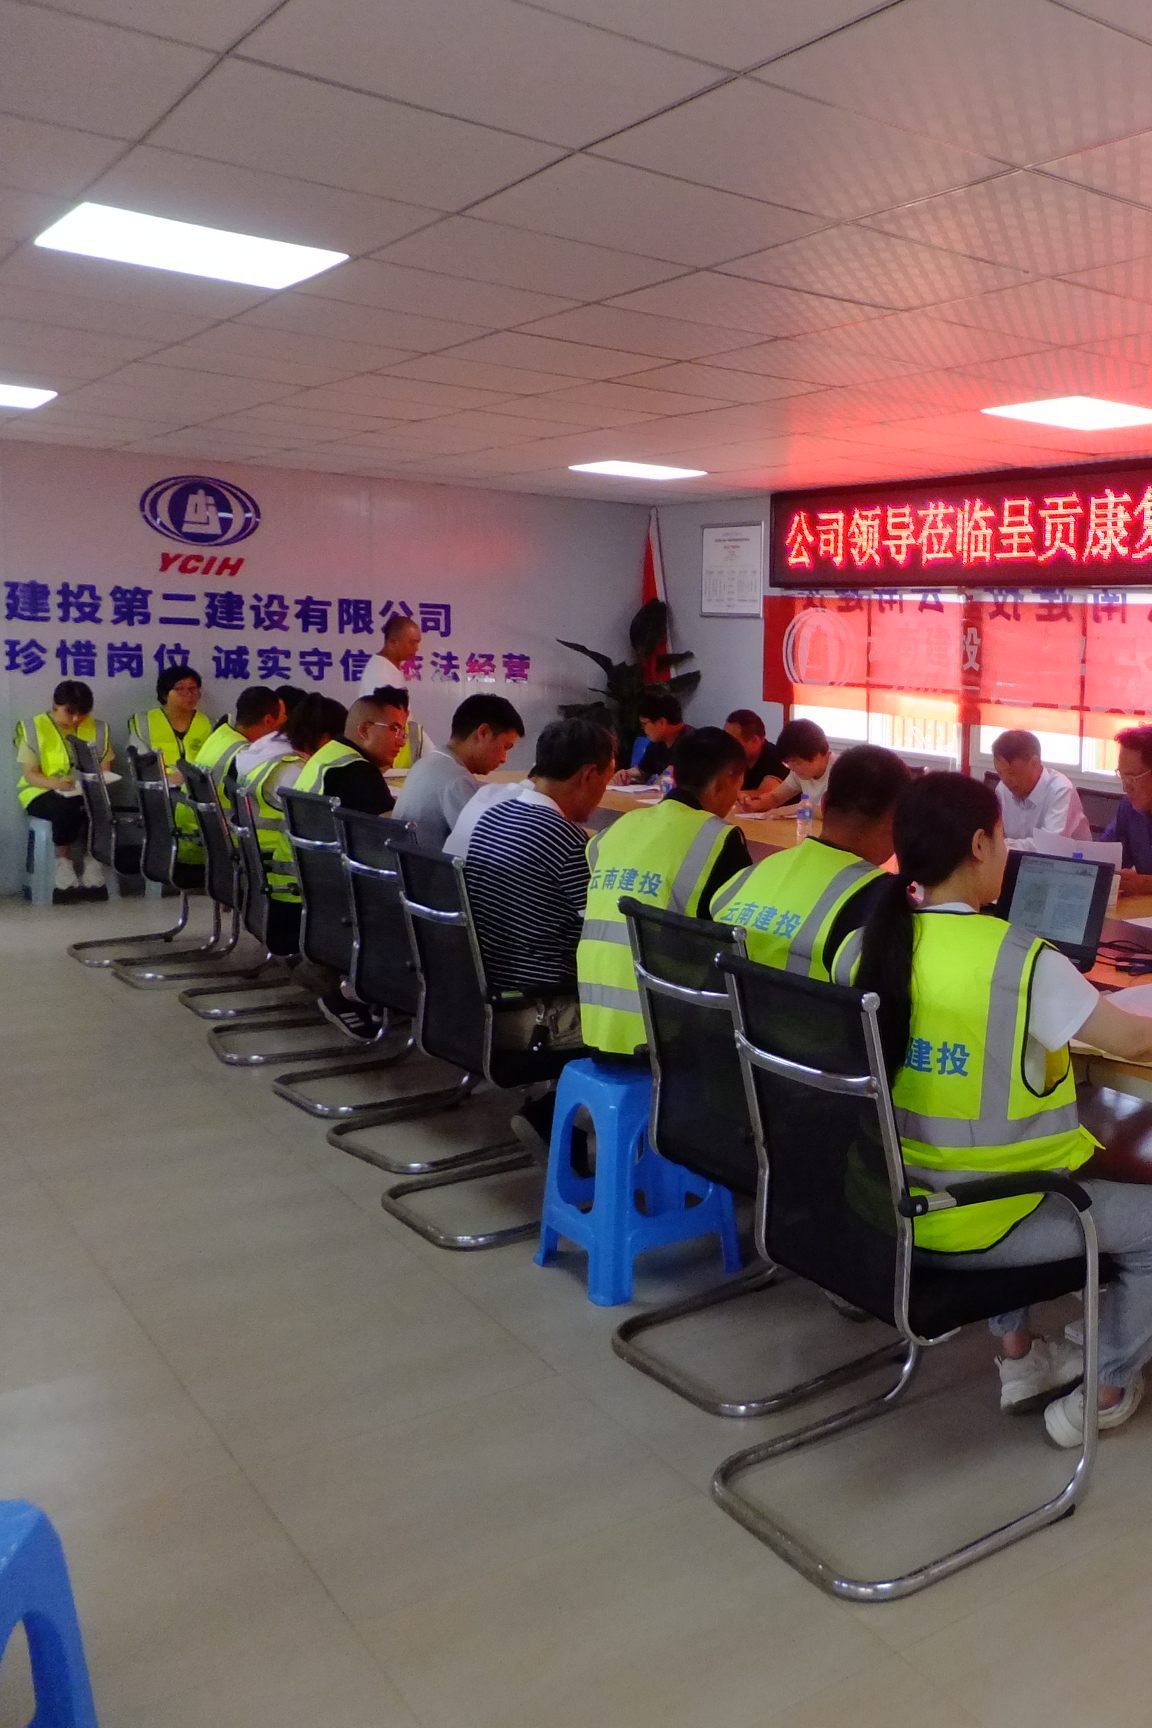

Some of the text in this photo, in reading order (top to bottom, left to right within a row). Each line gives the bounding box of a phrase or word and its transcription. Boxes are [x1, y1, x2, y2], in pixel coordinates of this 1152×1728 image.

[159, 552, 245, 576] YCIH
[590, 867, 662, 897] 云南建投
[720, 902, 802, 939] 云南建投
[905, 1037, 970, 1077] 建投
